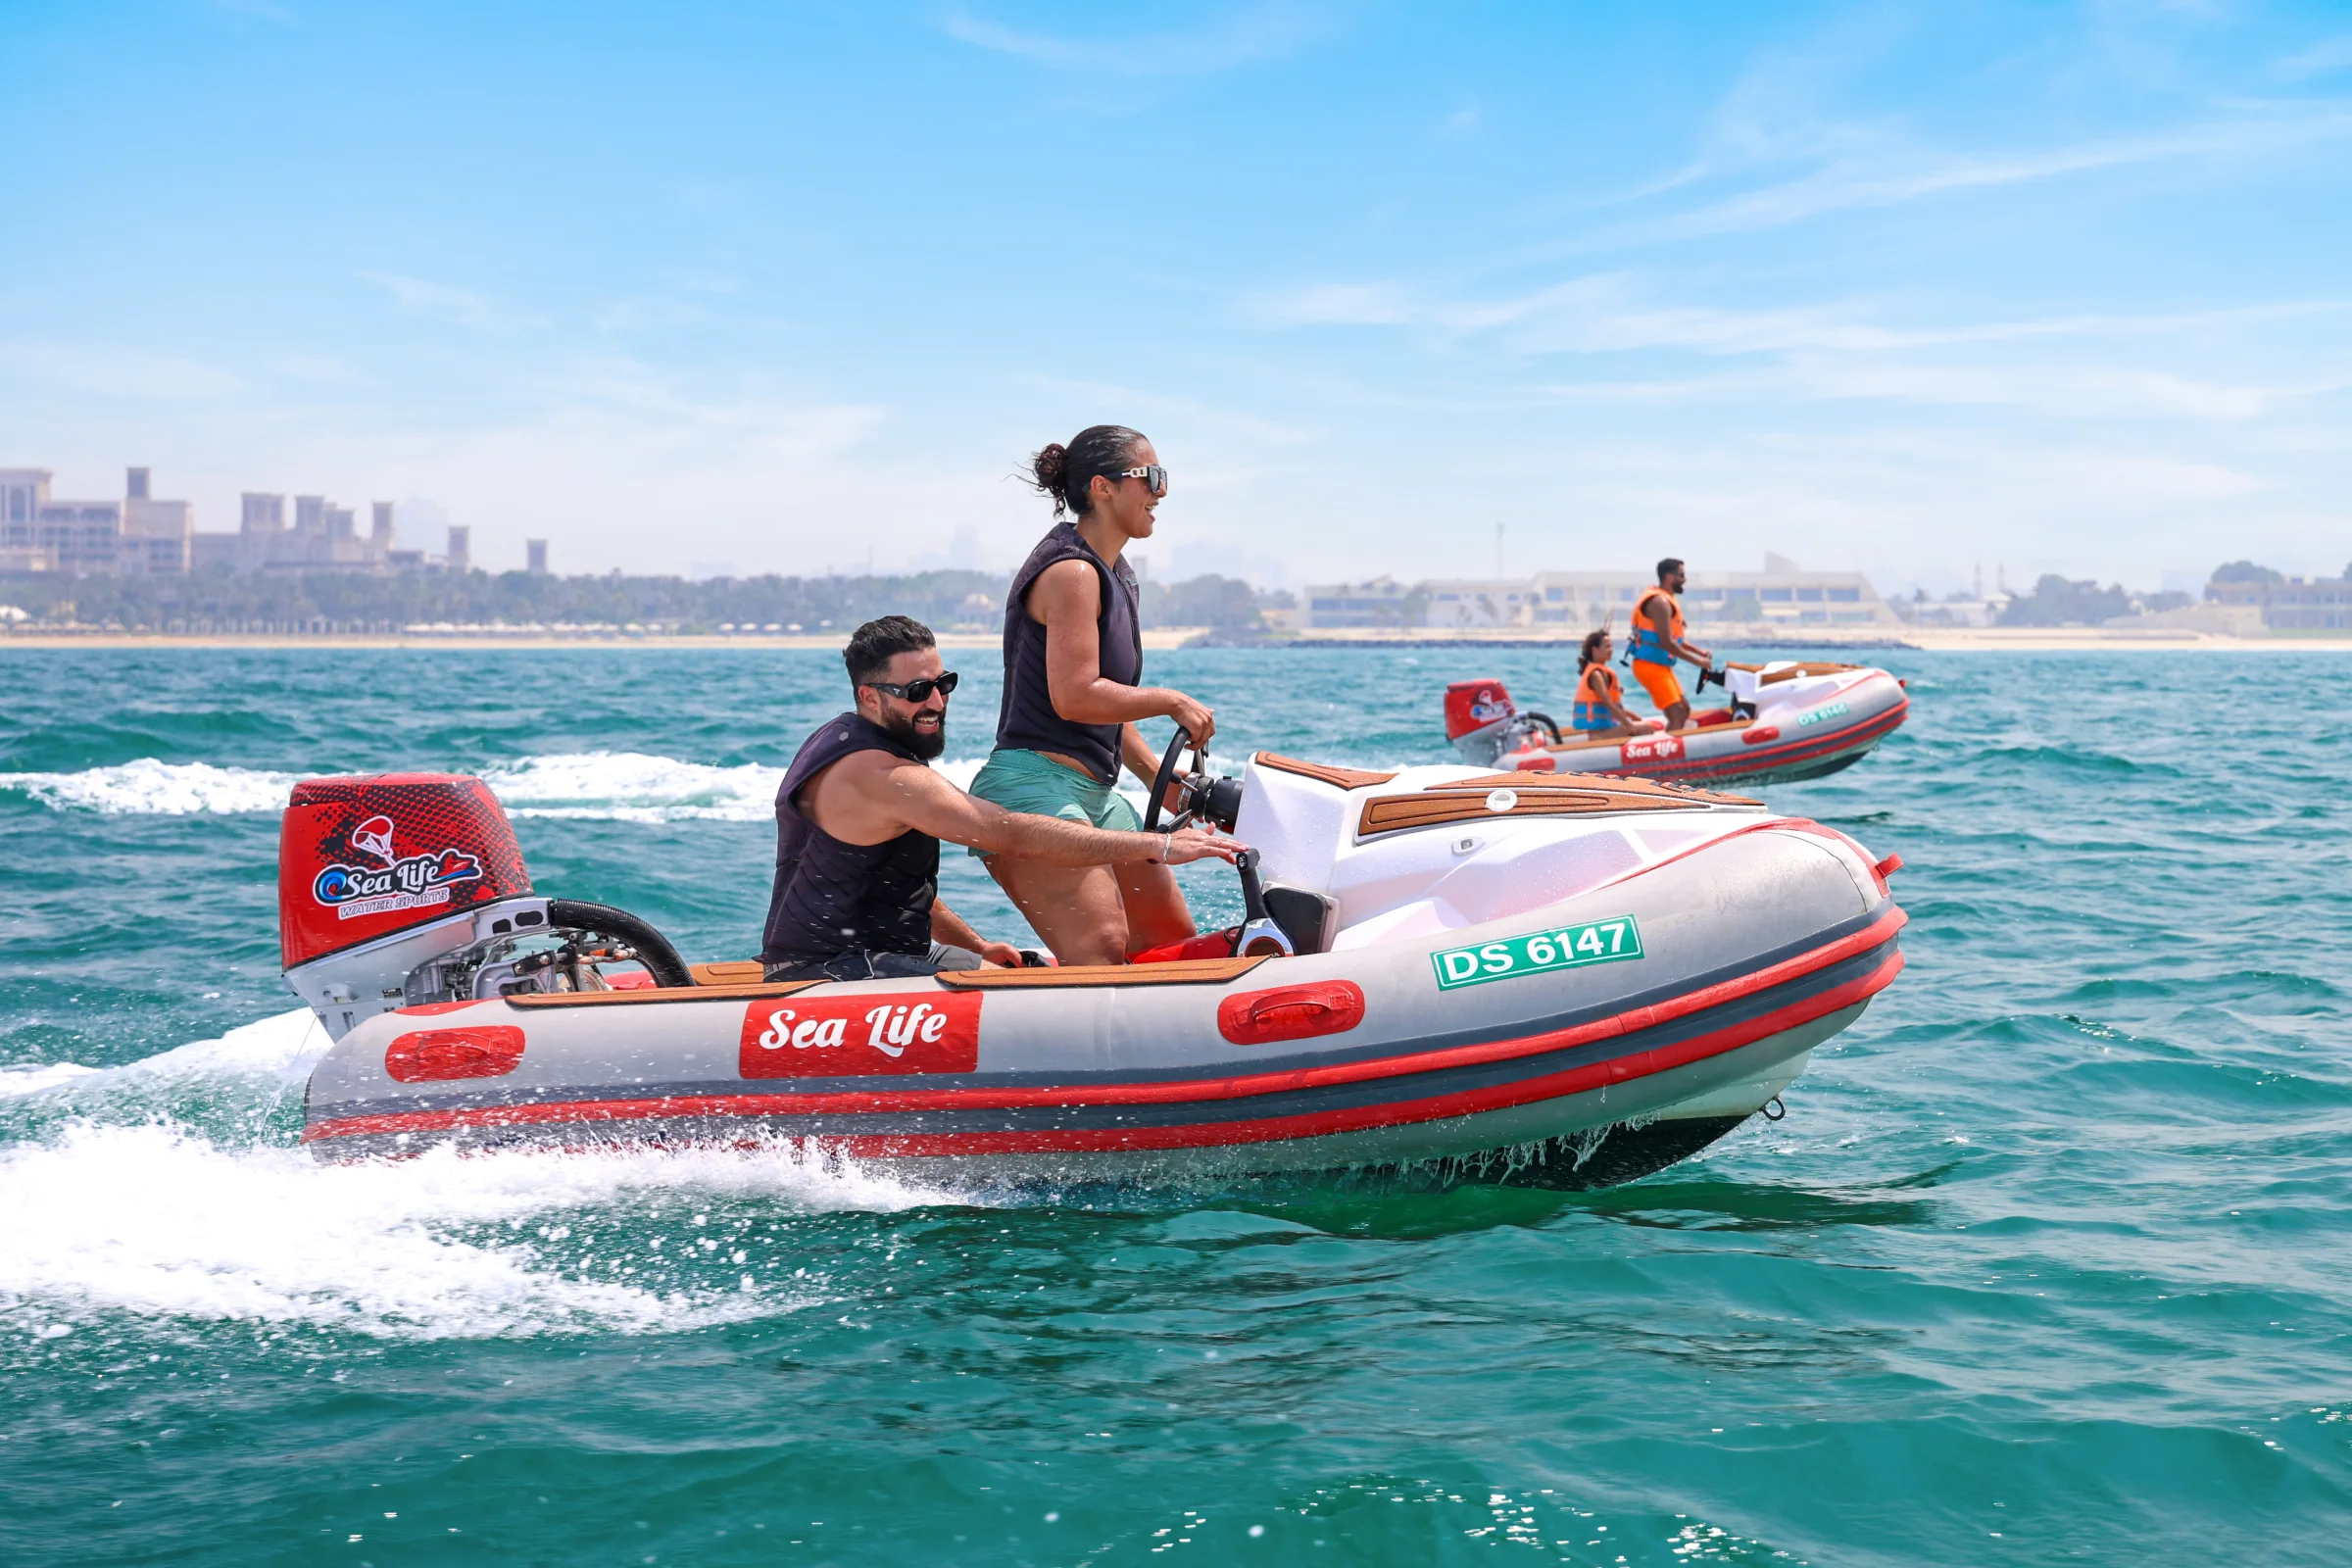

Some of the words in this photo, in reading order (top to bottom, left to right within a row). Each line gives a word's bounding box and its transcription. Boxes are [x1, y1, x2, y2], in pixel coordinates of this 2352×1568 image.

[1627, 745, 1651, 758] Sea
[1654, 740, 1678, 758] Life
[346, 873, 392, 898] Sea
[397, 860, 439, 892] Life
[340, 899, 393, 918] WATER
[396, 889, 448, 908] SPORTS
[1443, 944, 1515, 981] DS
[1526, 922, 1627, 965] 6147
[759, 1008, 848, 1050] Sea
[865, 1003, 948, 1057] Life
